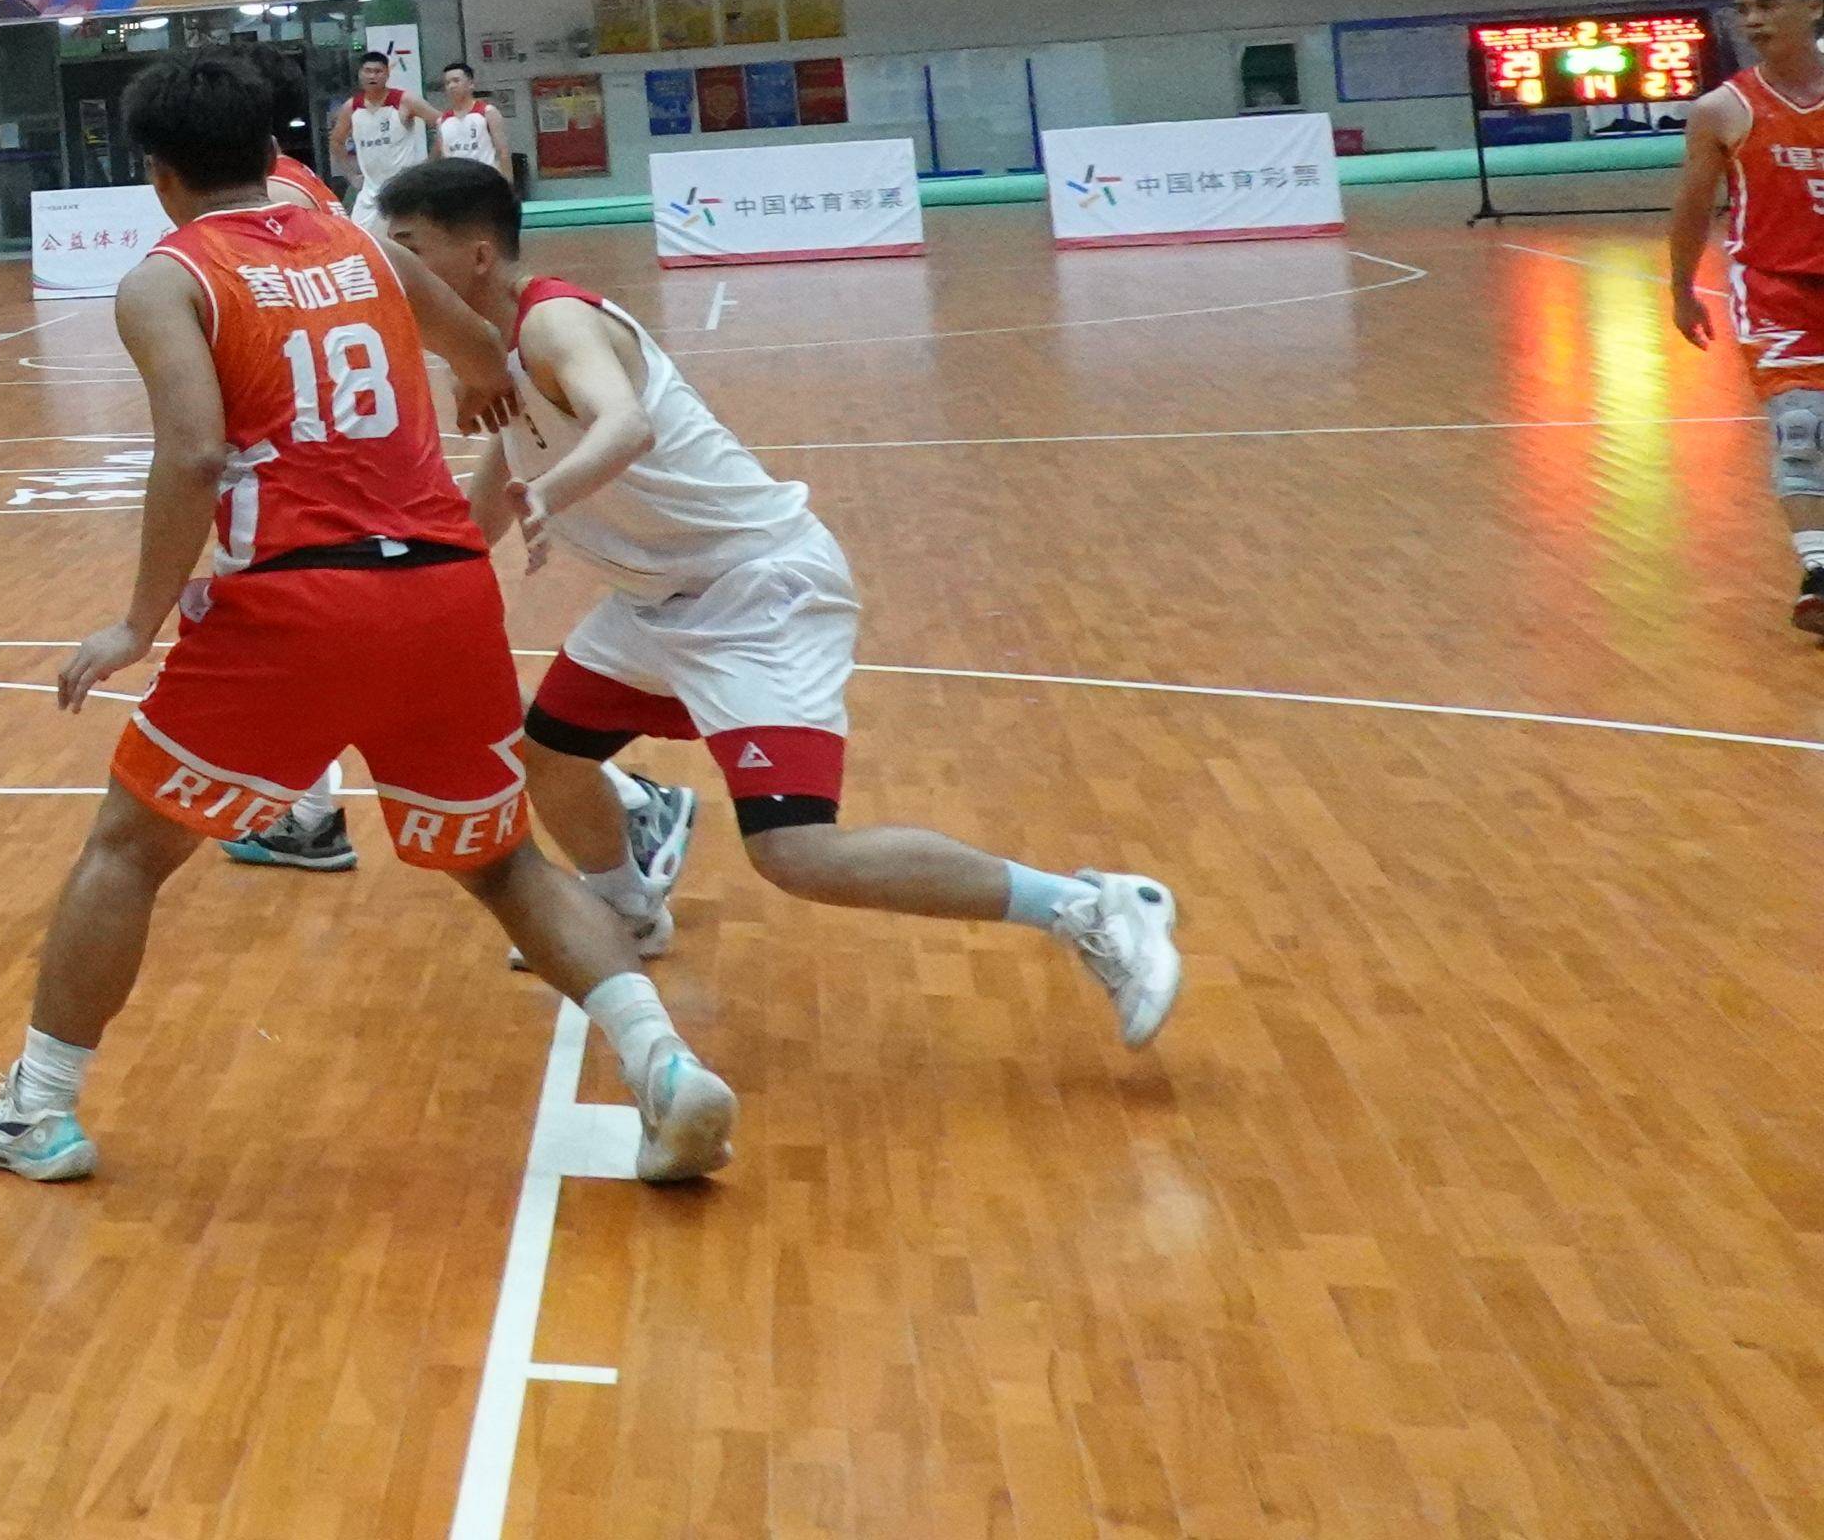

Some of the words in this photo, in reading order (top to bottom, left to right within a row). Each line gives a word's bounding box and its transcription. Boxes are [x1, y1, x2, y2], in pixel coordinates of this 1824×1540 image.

[1135, 163, 1321, 198] 中国体育彩票
[734, 186, 906, 219] 中国体育彩票
[41, 228, 139, 251] 公益体彩
[283, 322, 400, 444] 18
